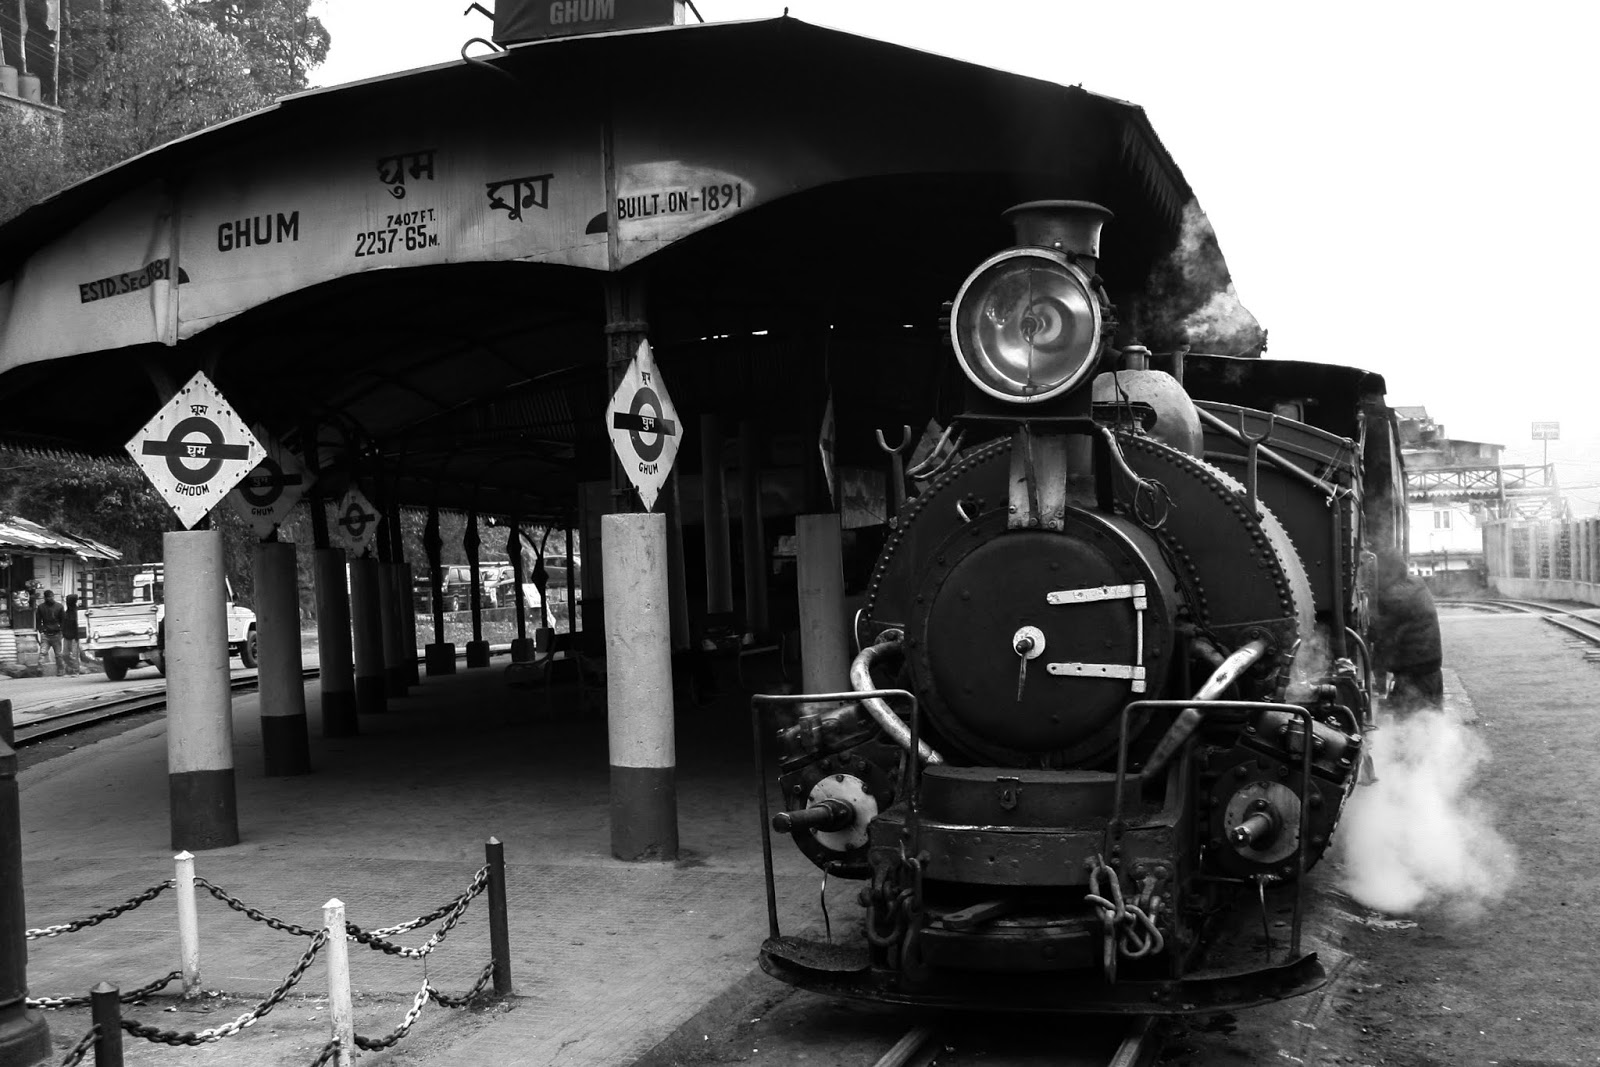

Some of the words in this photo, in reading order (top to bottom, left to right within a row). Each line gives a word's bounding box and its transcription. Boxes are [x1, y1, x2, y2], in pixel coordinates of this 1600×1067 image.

[550, 0, 615, 25] GHUM
[217, 210, 300, 252] GHUM
[638, 462, 659, 475] GHUM
[175, 482, 210, 497] GHOOM
[251, 506, 275, 517] GHUM
